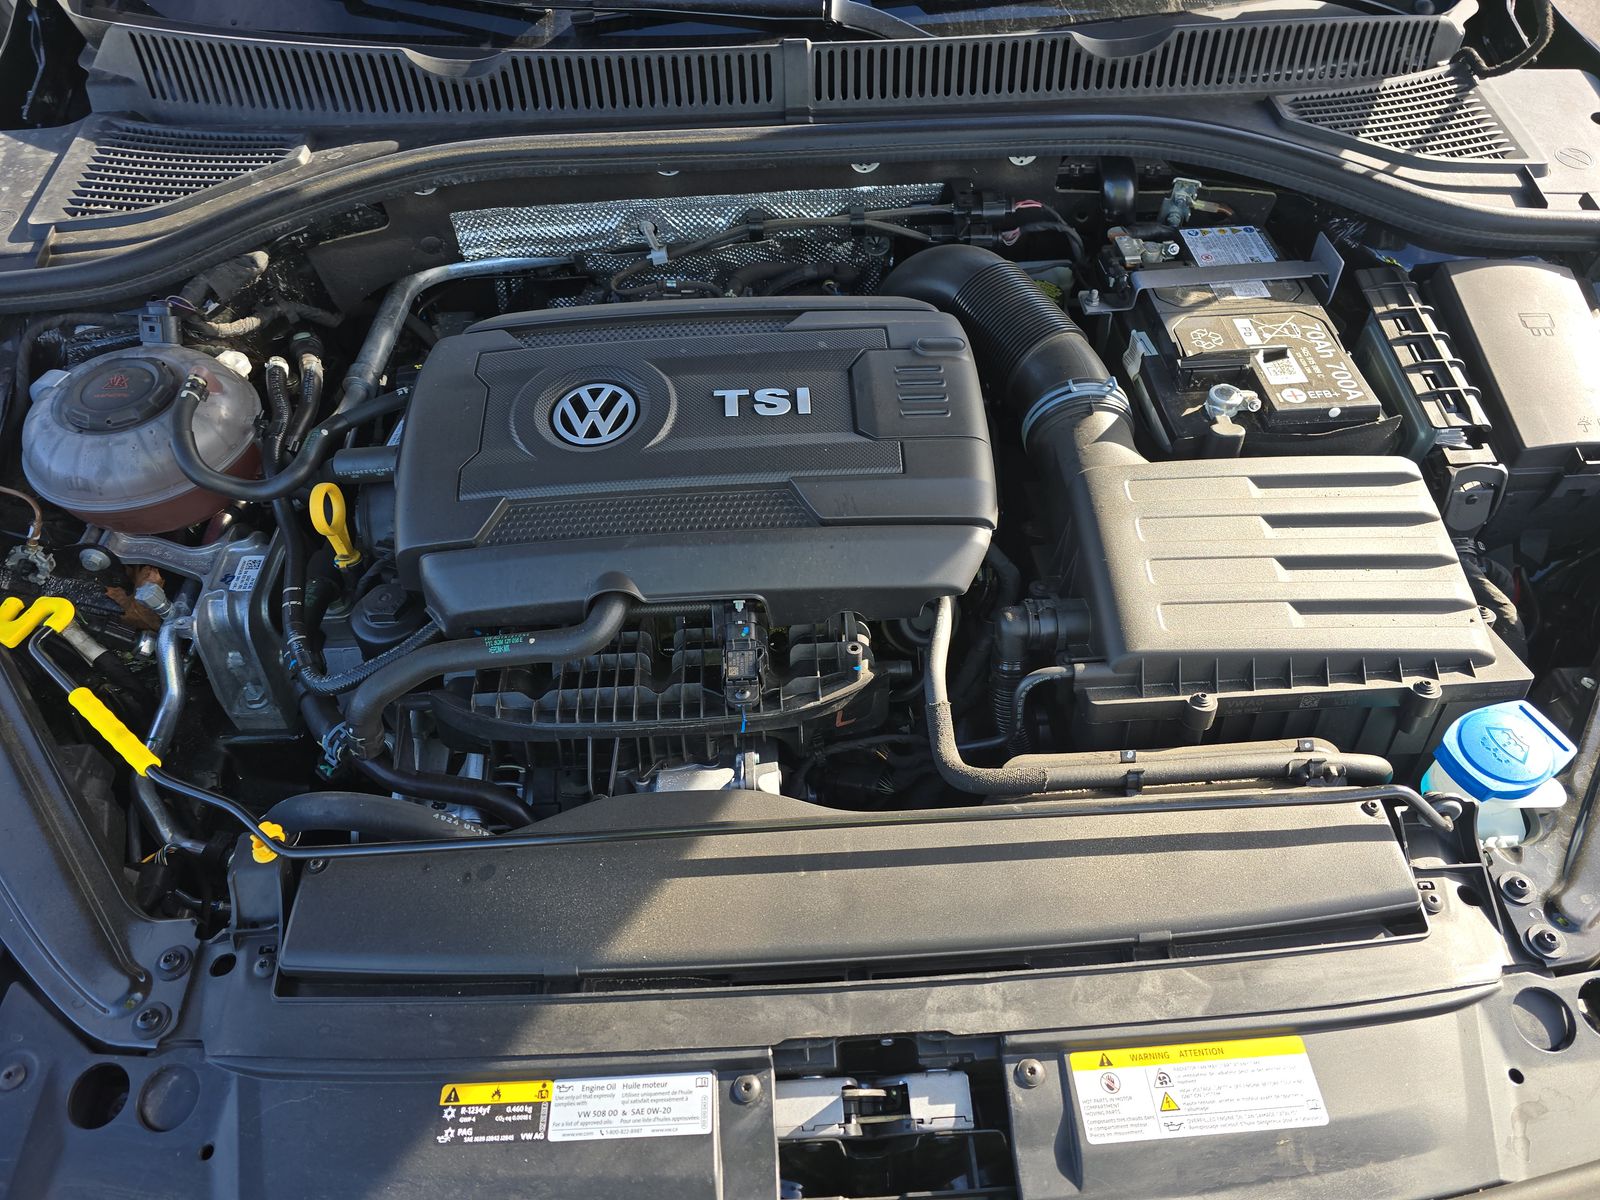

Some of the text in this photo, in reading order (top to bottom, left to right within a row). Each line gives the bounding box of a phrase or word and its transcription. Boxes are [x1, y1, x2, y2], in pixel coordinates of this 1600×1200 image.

[1300, 323, 1364, 400] 70Ah 700A
[1307, 389, 1340, 400] EFB+
[713, 387, 812, 417] TSI
[1130, 1048, 1224, 1062] WARNING ATTENTION
[582, 1084, 605, 1093] Engine
[460, 1104, 532, 1116] R-1234yf 0.460 kg
[646, 1106, 672, 1114] 0W-20
[457, 1128, 472, 1136] PAG
[520, 1132, 545, 1140] VW AG
